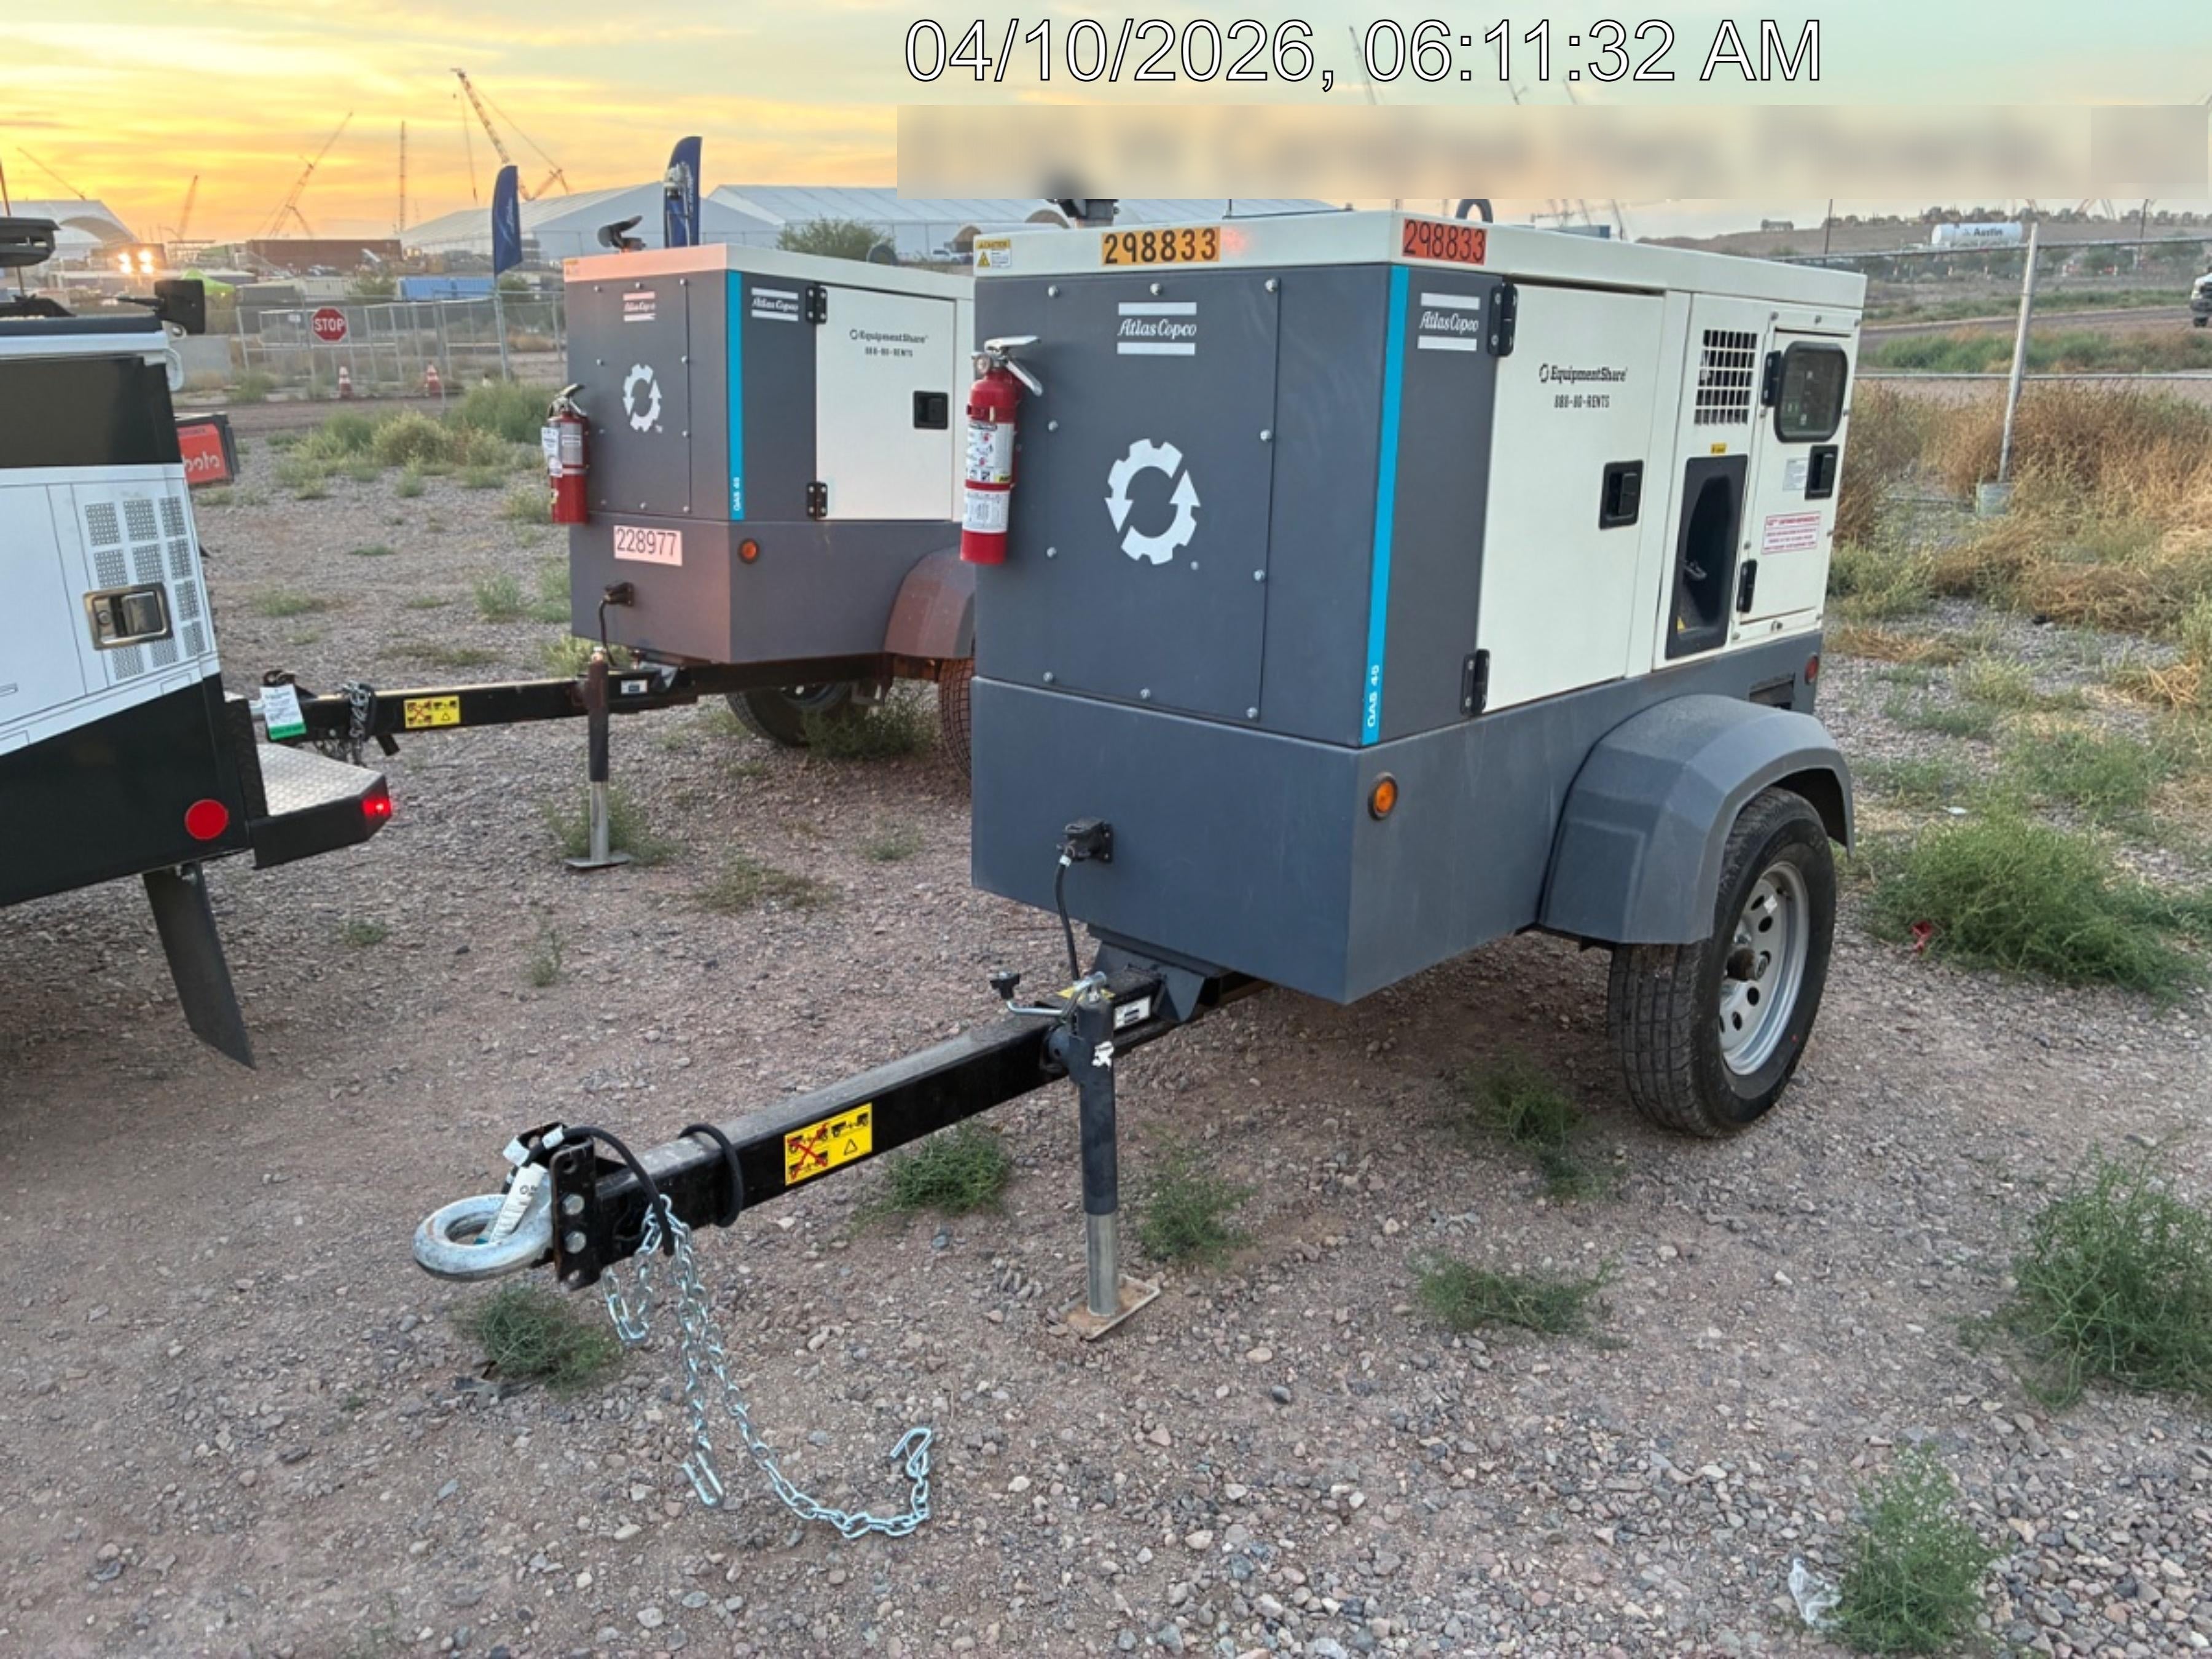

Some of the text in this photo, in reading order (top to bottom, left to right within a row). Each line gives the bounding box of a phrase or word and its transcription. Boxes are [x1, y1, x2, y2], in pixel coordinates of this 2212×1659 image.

[1104, 228, 1217, 264] 298833
[1403, 219, 1486, 262] 298833
[314, 318, 344, 332] STOP
[1117, 318, 1198, 340] Atlas Copco
[1419, 311, 1480, 335] Atlas Copco
[1550, 364, 1627, 385] EquipmentShare
[616, 527, 678, 557] 228977
